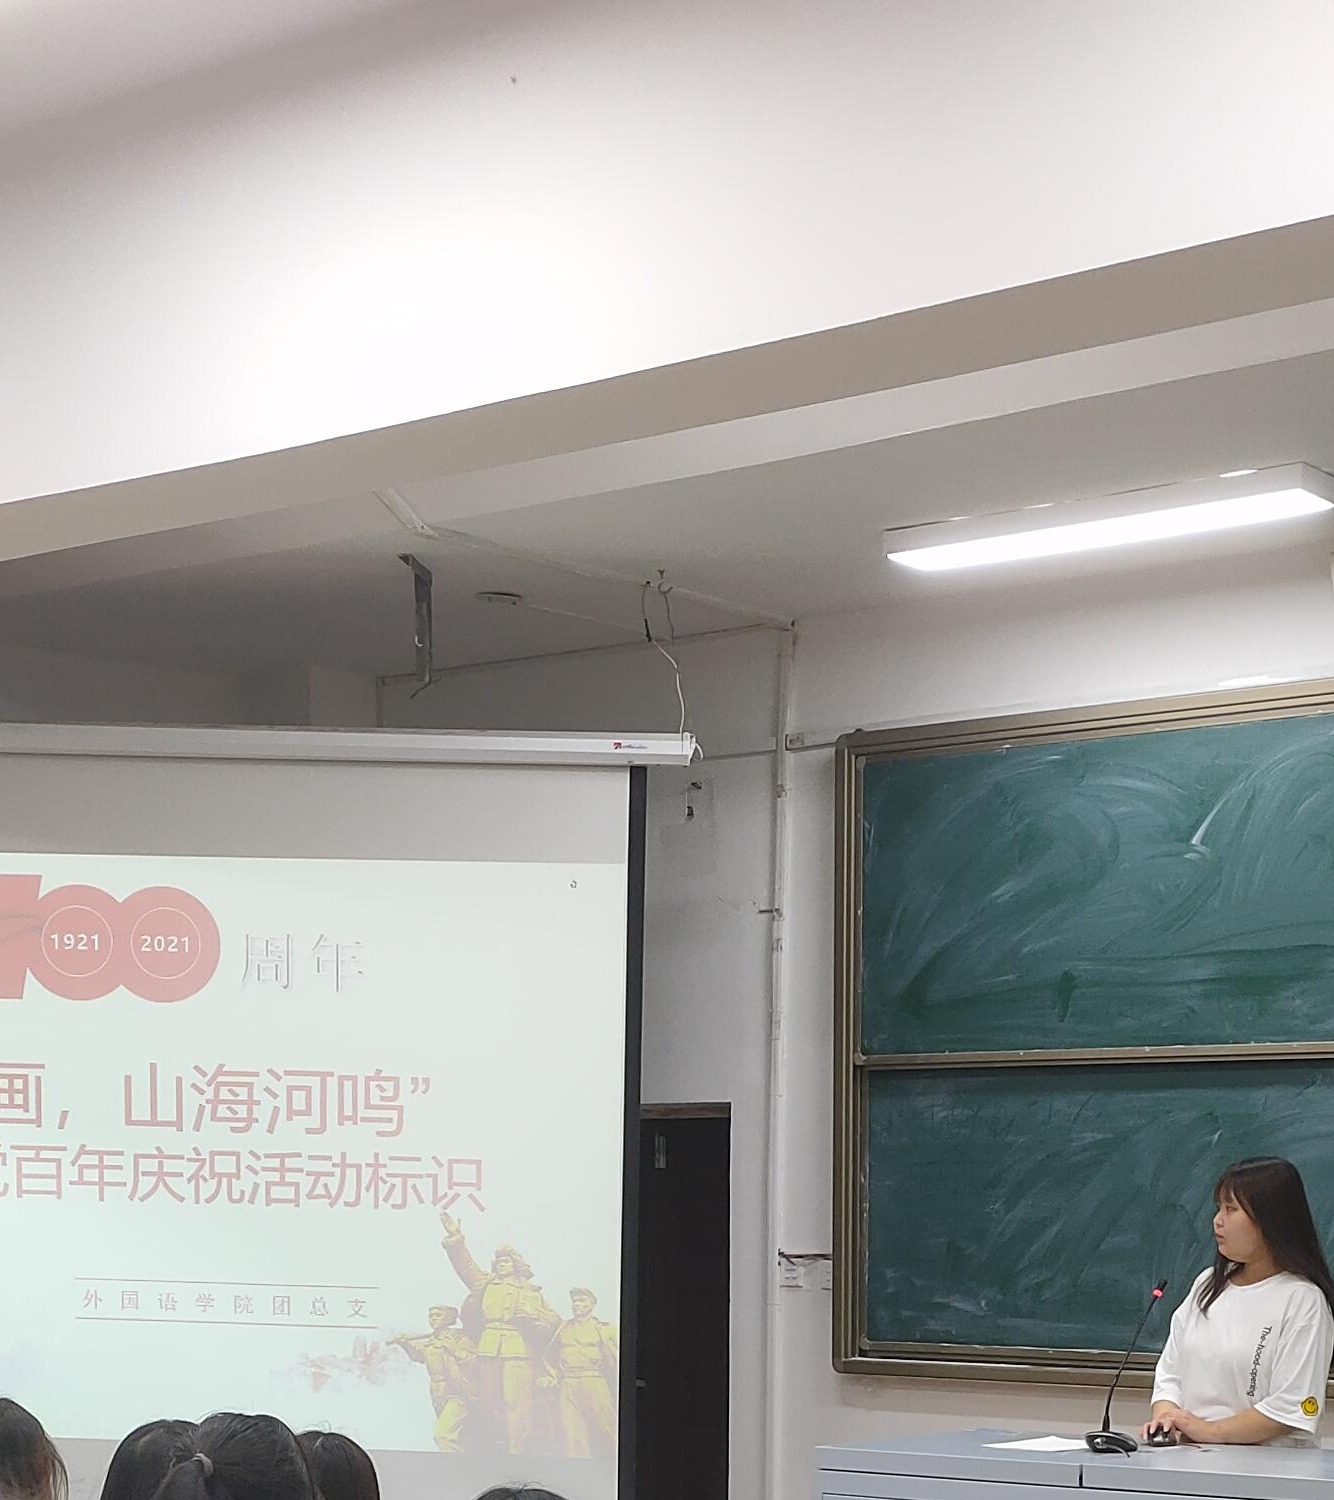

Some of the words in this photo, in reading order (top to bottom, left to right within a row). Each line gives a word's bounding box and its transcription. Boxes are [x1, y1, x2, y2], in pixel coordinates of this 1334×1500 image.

[50, 932, 102, 951] 1921
[140, 934, 191, 953] 2021
[240, 932, 366, 993] 周年
[83, 1288, 368, 1318] 外国语学院团总支
